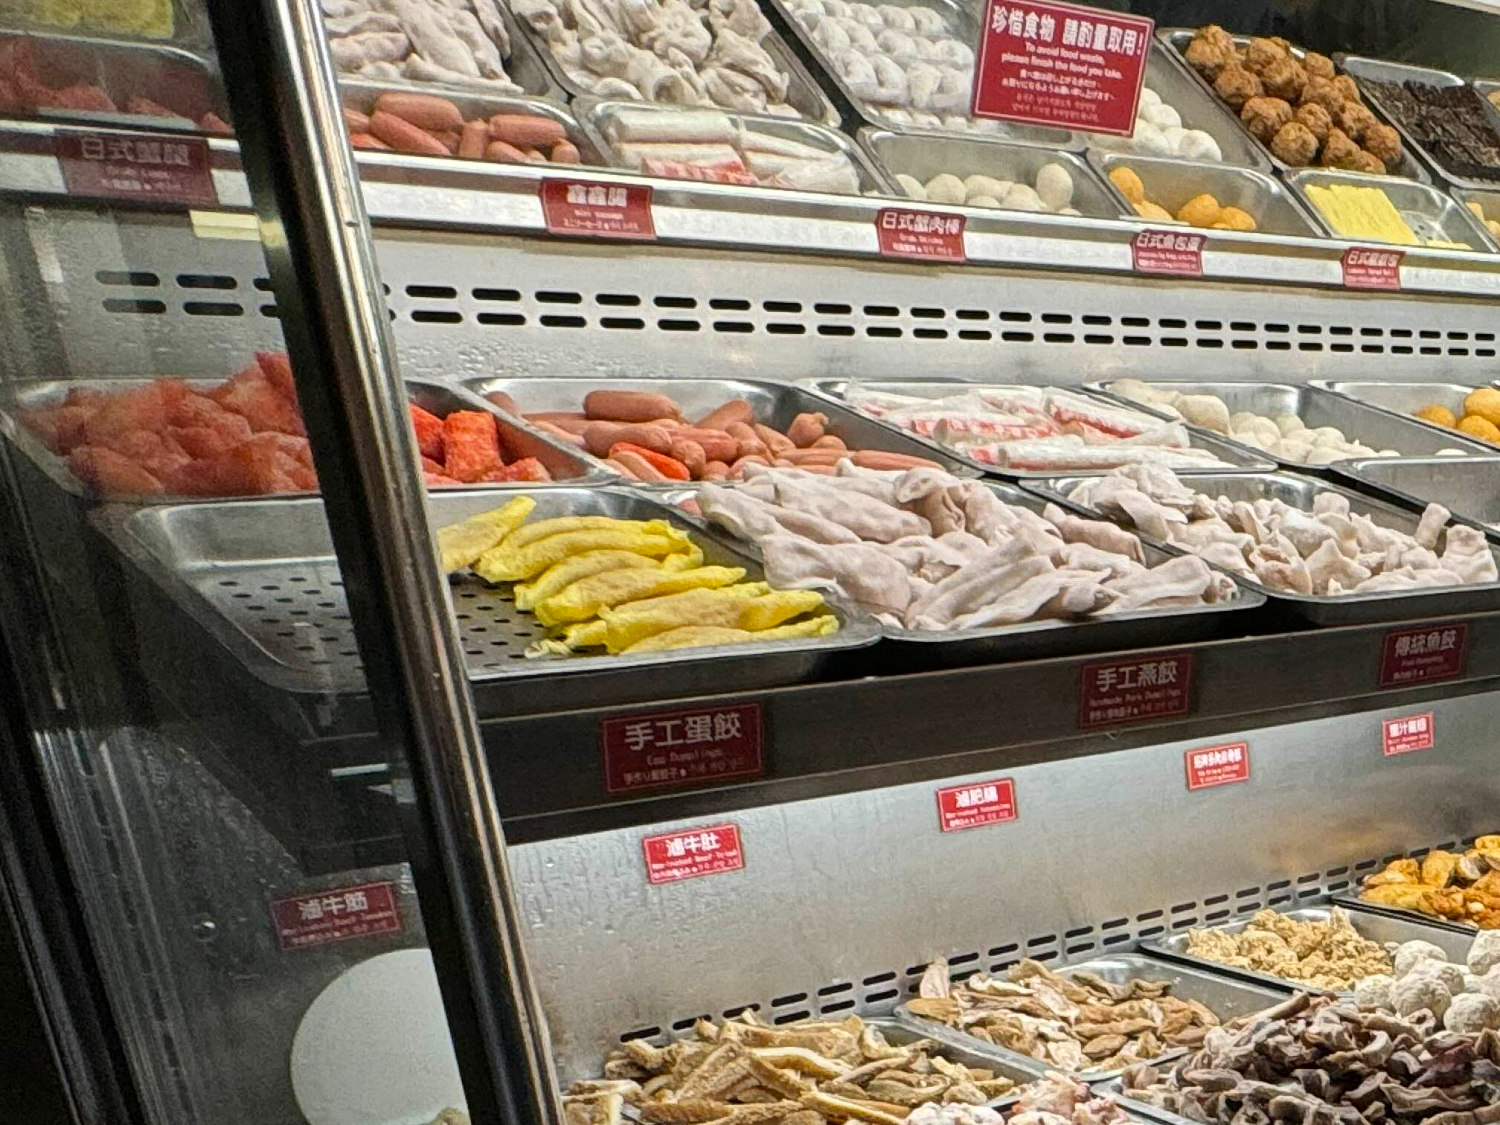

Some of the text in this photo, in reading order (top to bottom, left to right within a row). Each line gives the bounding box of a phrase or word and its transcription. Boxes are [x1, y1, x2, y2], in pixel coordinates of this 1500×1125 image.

[991, 5, 1144, 56] 珍惜食物 請酌量取用!
[1055, 58, 1068, 70] the
[1069, 62, 1087, 74] food
[1060, 48, 1079, 60] food
[1096, 661, 1178, 692] 手工燕餃
[624, 712, 742, 751] 手工蛋餃
[665, 832, 721, 857] 滷牛肚
